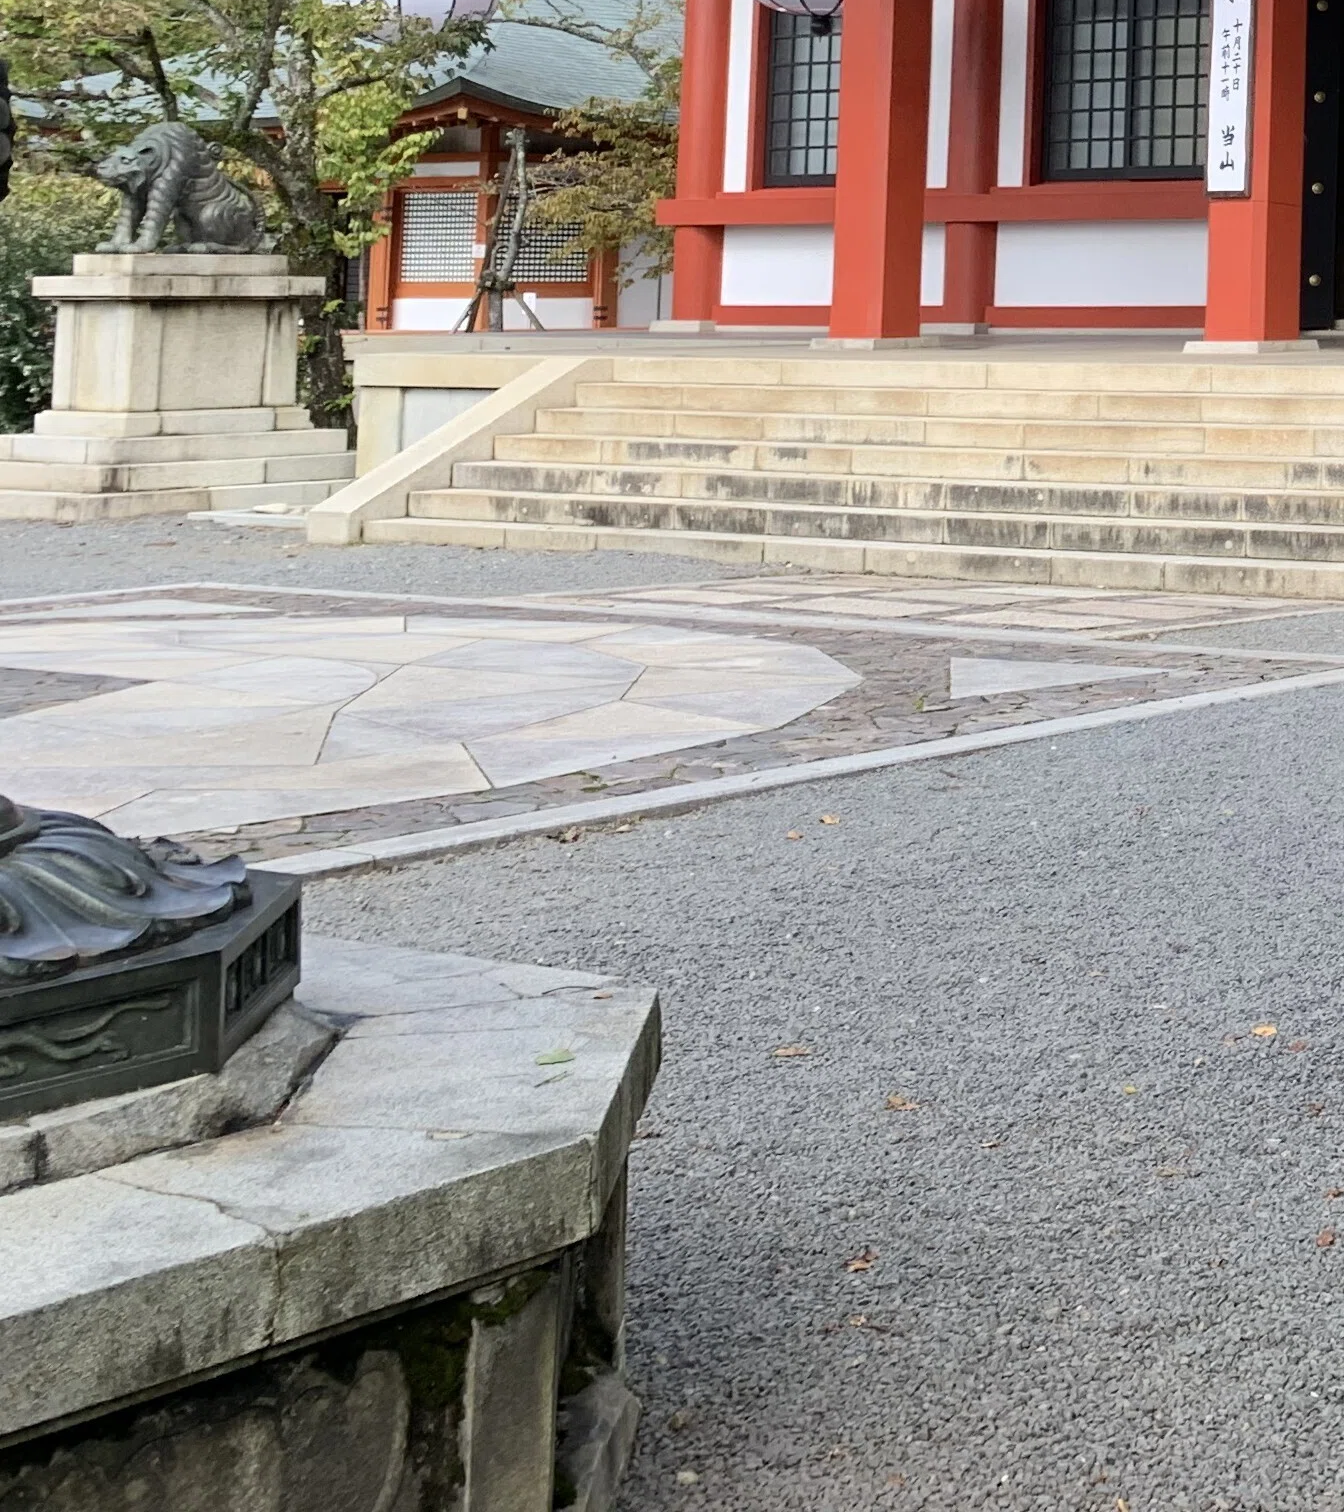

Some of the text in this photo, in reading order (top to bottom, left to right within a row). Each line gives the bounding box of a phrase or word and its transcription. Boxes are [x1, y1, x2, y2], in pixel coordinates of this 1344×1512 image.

[1220, 28, 1232, 102] 午前十一時
[1231, 17, 1244, 92] 十月二十日
[1219, 124, 1236, 172] 当山
